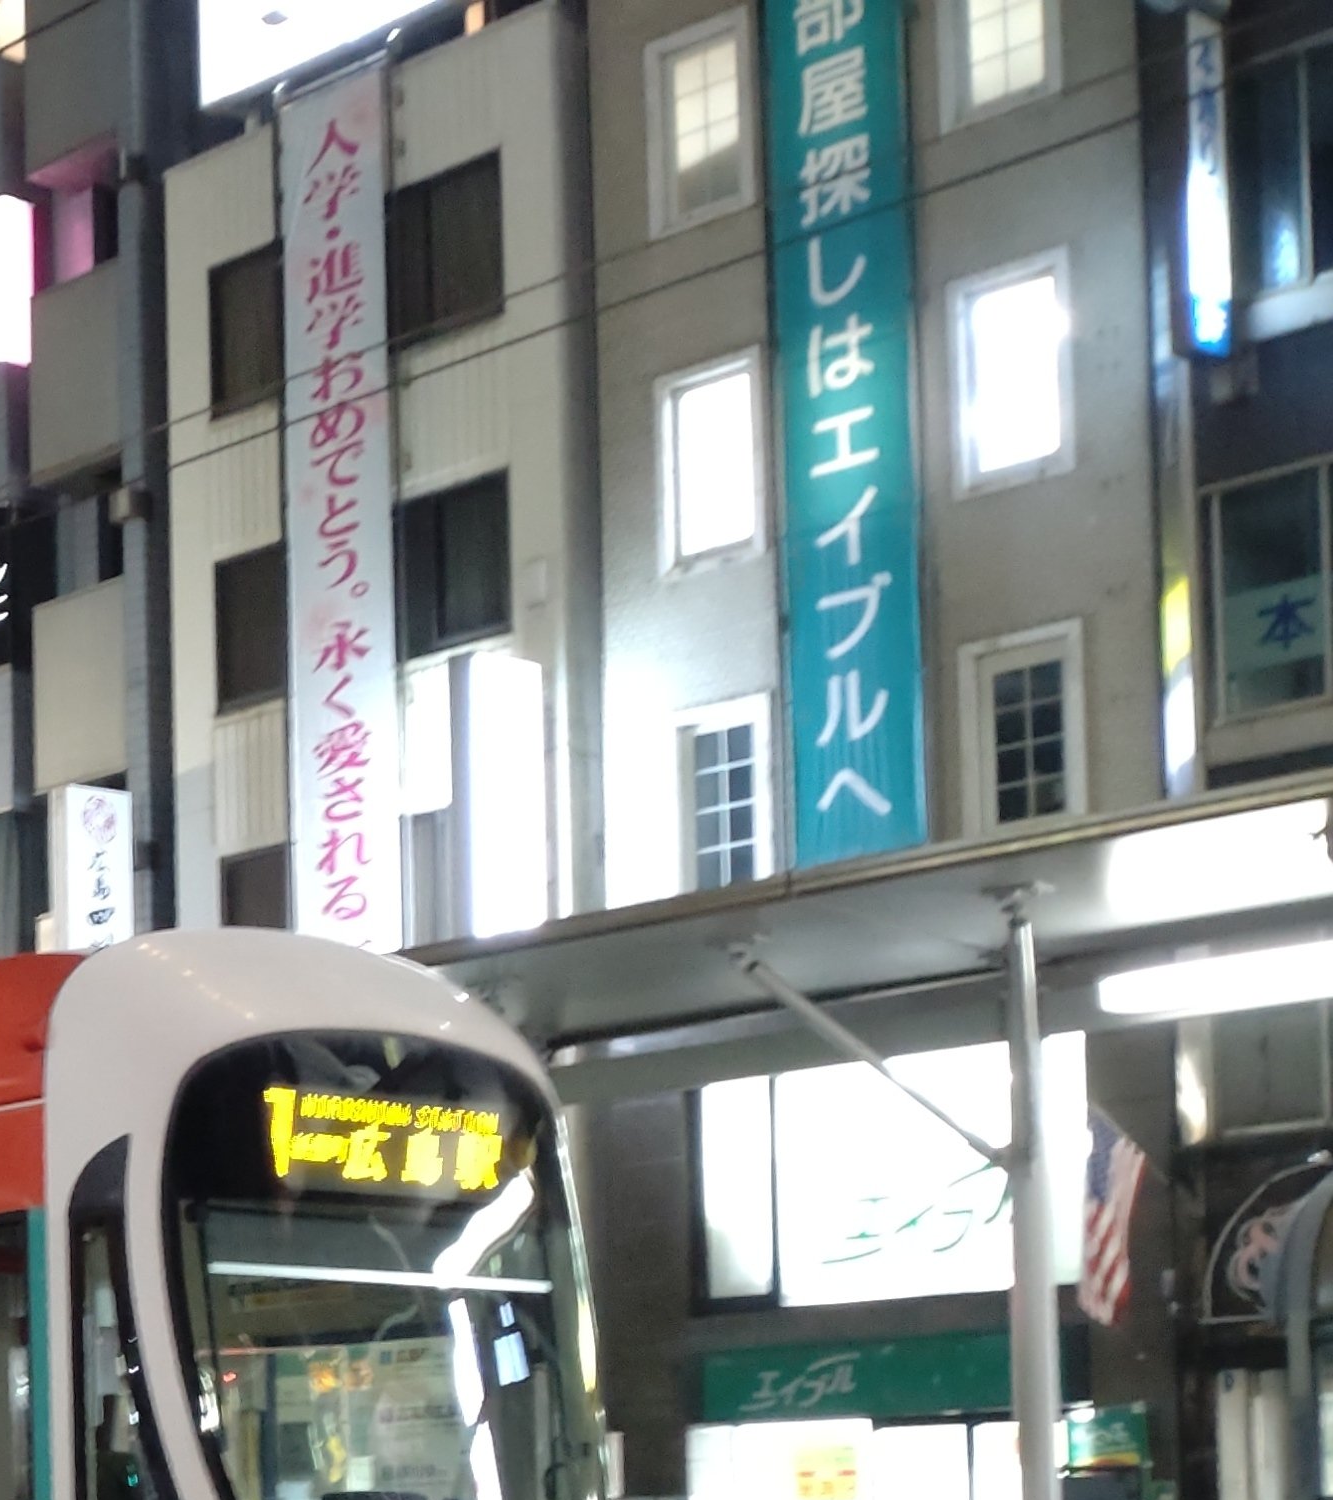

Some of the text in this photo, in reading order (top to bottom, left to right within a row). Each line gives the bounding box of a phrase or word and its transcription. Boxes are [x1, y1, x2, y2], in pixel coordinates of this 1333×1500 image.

[263, 1086, 296, 1178] 1
[737, 1351, 861, 1412] エイブル
